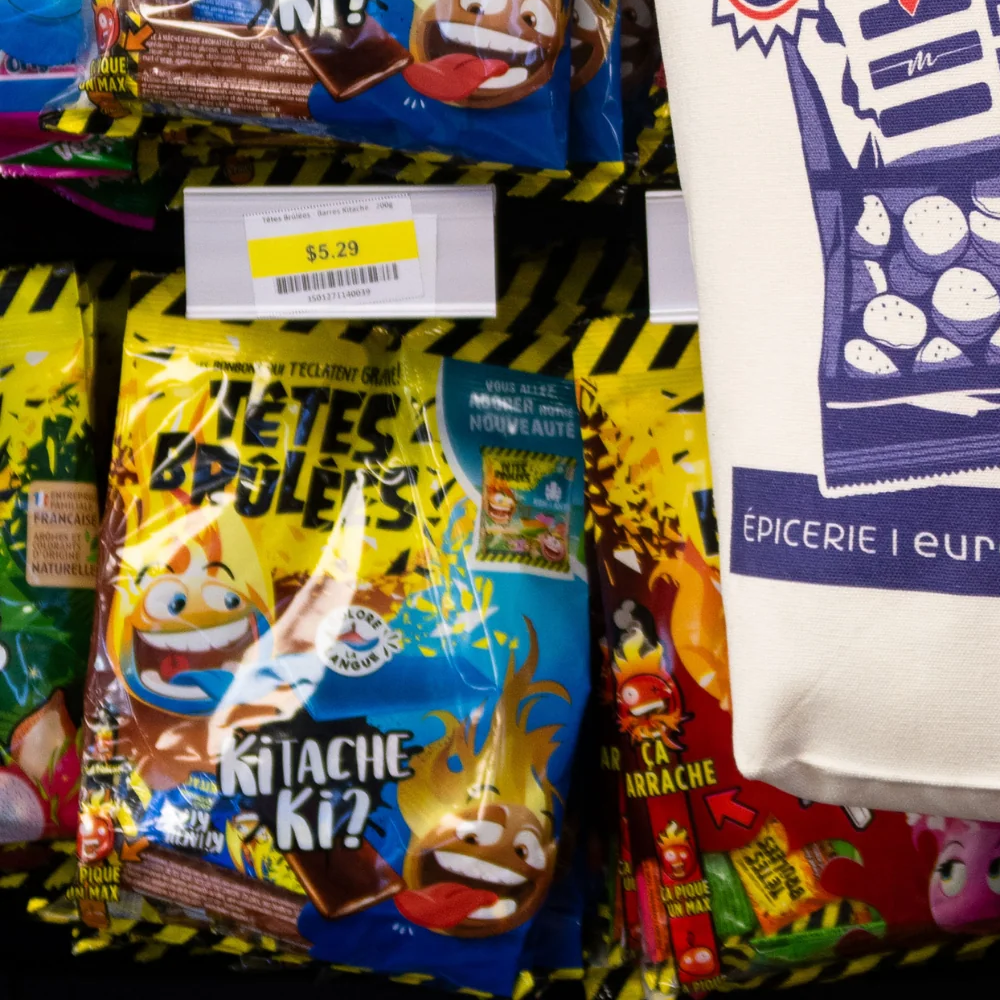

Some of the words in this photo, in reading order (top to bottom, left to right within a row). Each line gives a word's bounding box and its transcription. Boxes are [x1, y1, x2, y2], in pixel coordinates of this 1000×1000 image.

[97, 77, 126, 93] MAX
[305, 239, 360, 264] $5.29
[485, 379, 516, 394] VOUS
[209, 379, 401, 464] TÊTES
[469, 414, 576, 439] NOUVEAUTÉ
[743, 507, 877, 553] ÉPICERIE
[328, 651, 381, 672] ANGUE
[641, 740, 670, 769] ÇA
[626, 759, 718, 798] ARRACHE
[80, 865, 121, 887] PIQUE
[89, 884, 120, 901] MAX
[677, 879, 711, 897] PIQUE
[667, 901, 683, 918] UN
[685, 898, 713, 917] MAX
